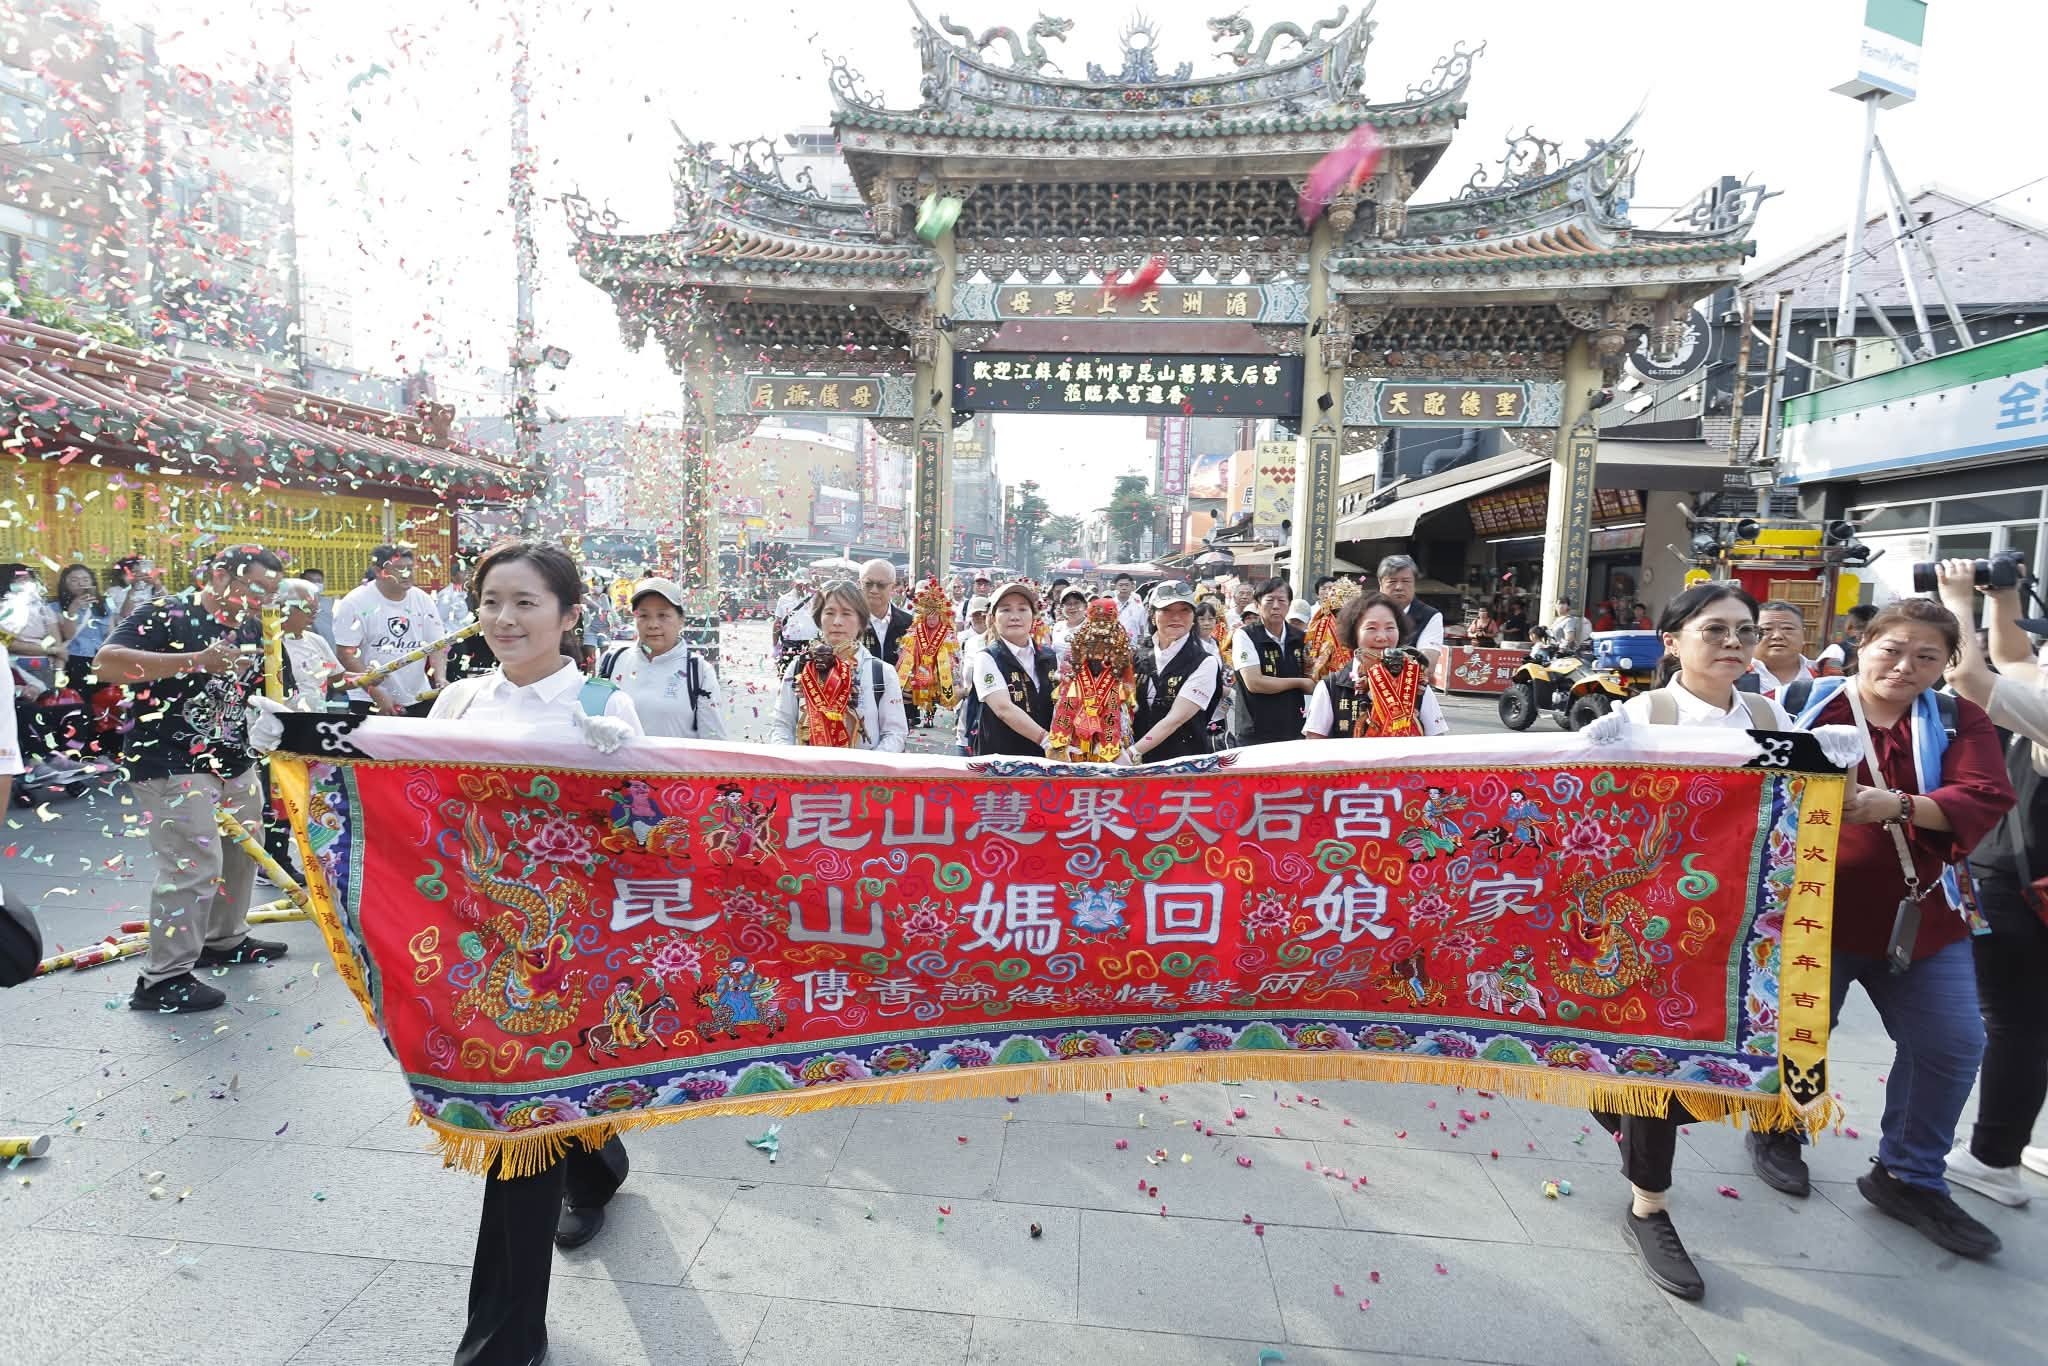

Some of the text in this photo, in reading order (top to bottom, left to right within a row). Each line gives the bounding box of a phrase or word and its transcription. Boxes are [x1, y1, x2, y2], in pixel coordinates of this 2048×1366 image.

[1387, 391, 1517, 417] 聖德配天
[1996, 381, 2048, 430] 全
[784, 783, 1403, 850] 昆山慧聚天后宮
[609, 872, 1543, 956] 昆山媽回娘家
[1788, 808, 1832, 1046] 歲次丙午年吉旦
